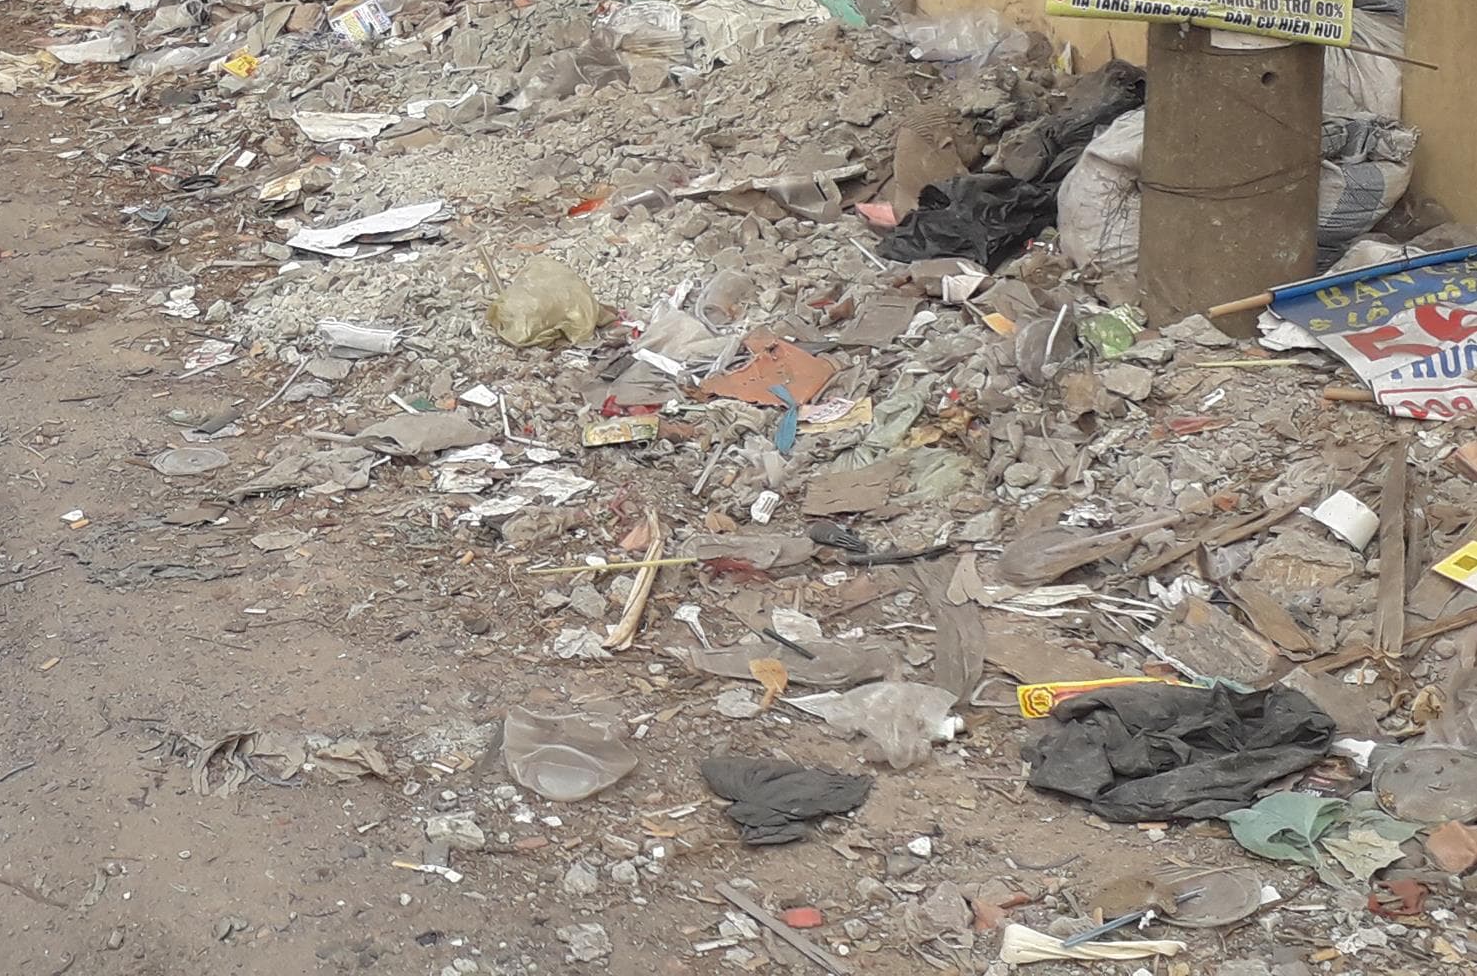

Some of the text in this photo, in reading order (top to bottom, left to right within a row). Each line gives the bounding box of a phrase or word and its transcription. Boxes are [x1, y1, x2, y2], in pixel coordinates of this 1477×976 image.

[1133, 0, 1172, 17] XONG
[1278, 17, 1311, 36] HIỆN
[1315, 0, 1345, 20] 60%
